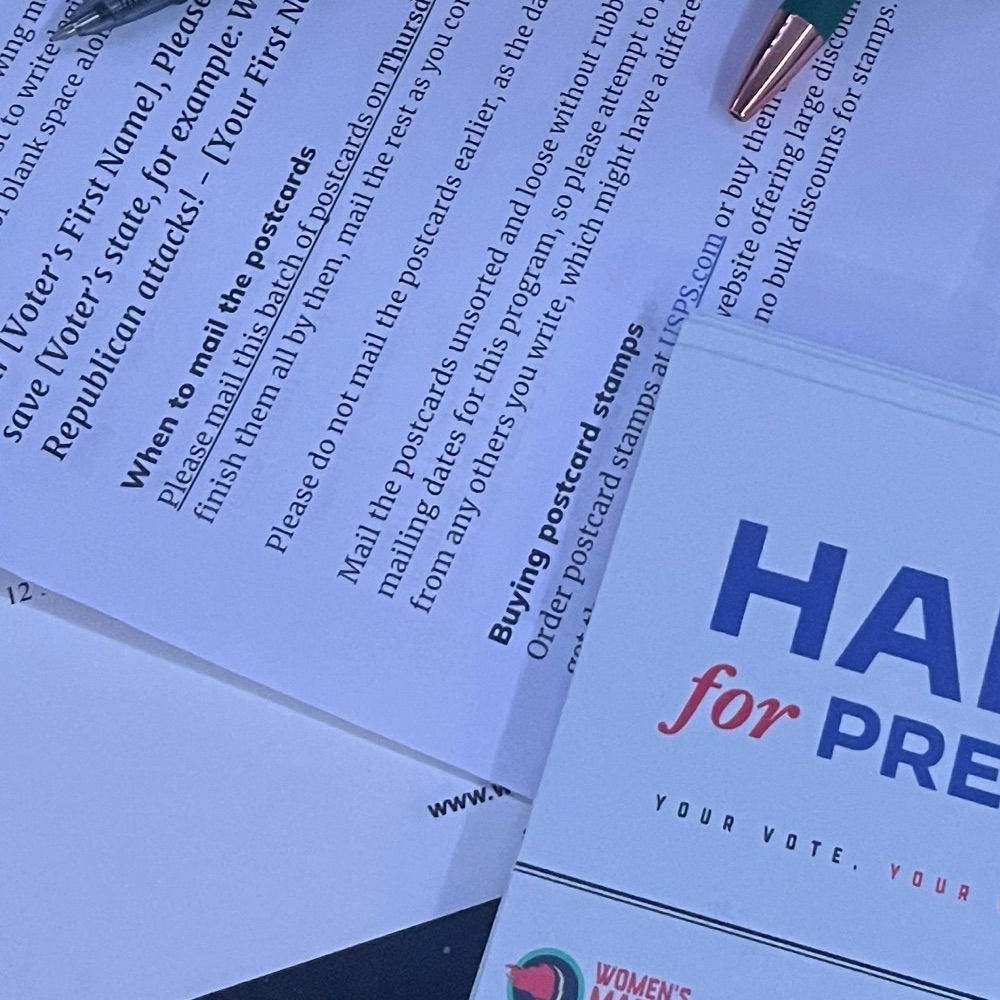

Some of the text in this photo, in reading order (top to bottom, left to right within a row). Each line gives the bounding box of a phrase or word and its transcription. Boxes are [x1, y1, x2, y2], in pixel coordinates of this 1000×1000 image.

[366, 81, 395, 113] on
[548, 49, 601, 134] without
[57, 176, 111, 242] First
[94, 81, 172, 177] Name],
[308, 112, 378, 226] postcards
[514, 139, 559, 199] loose
[719, 155, 759, 199] buy
[753, 3, 898, 324] no bulk discounts for stamps.
[2, 378, 51, 444] save
[33, 266, 114, 377] [Voter's
[104, 195, 162, 265] state,
[141, 144, 178, 191] for
[171, 25, 244, 142] example:
[40, 304, 147, 461] Republican
[138, 188, 205, 300] attacks!
[200, 87, 257, 166] [Your
[243, 25, 292, 87] First
[295, 219, 323, 254] of
[500, 199, 531, 246] and
[714, 201, 736, 229] or
[119, 146, 317, 489] When to mail the postcards
[253, 254, 309, 324] batch
[448, 246, 510, 353] unsorted
[657, 233, 727, 347] USPS.com
[232, 322, 274, 373] this
[651, 351, 671, 378] at
[204, 371, 248, 432] mail
[391, 357, 458, 480] postcards
[612, 380, 662, 470] stamps
[156, 431, 219, 512] Please
[368, 480, 402, 521] the
[487, 548, 551, 646] Buying
[537, 421, 602, 545] postcard
[593, 322, 645, 419] stamps
[336, 524, 381, 586] Mail
[562, 471, 622, 586] postcard
[7, 582, 33, 605] 12
[526, 584, 573, 661] Order
[657, 663, 801, 739] for
[656, 794, 734, 832] YOUR
[764, 826, 857, 870] VOTE.
[891, 863, 970, 901] YOUR
[597, 961, 693, 1000] WOMEN'S
